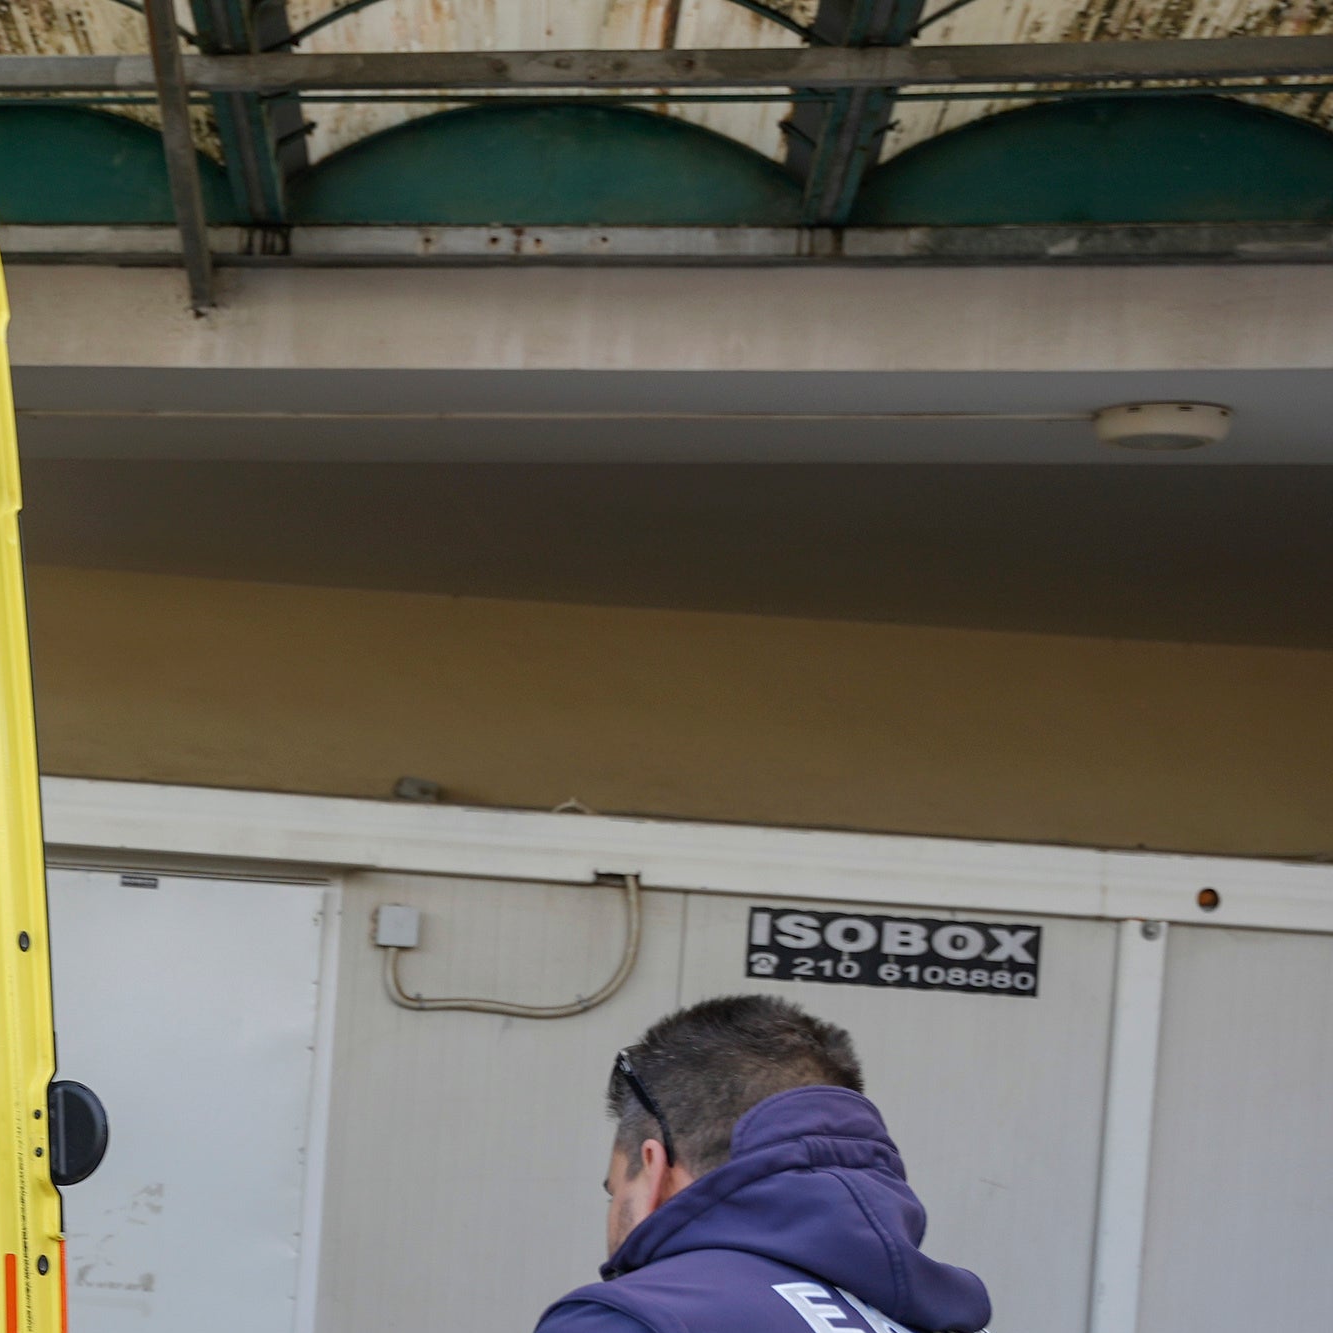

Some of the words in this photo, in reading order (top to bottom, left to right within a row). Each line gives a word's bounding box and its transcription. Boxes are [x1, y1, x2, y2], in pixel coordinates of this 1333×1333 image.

[751, 912, 1036, 964] ISOBOX
[791, 957, 860, 978] 210
[878, 962, 1035, 990] 6108880
